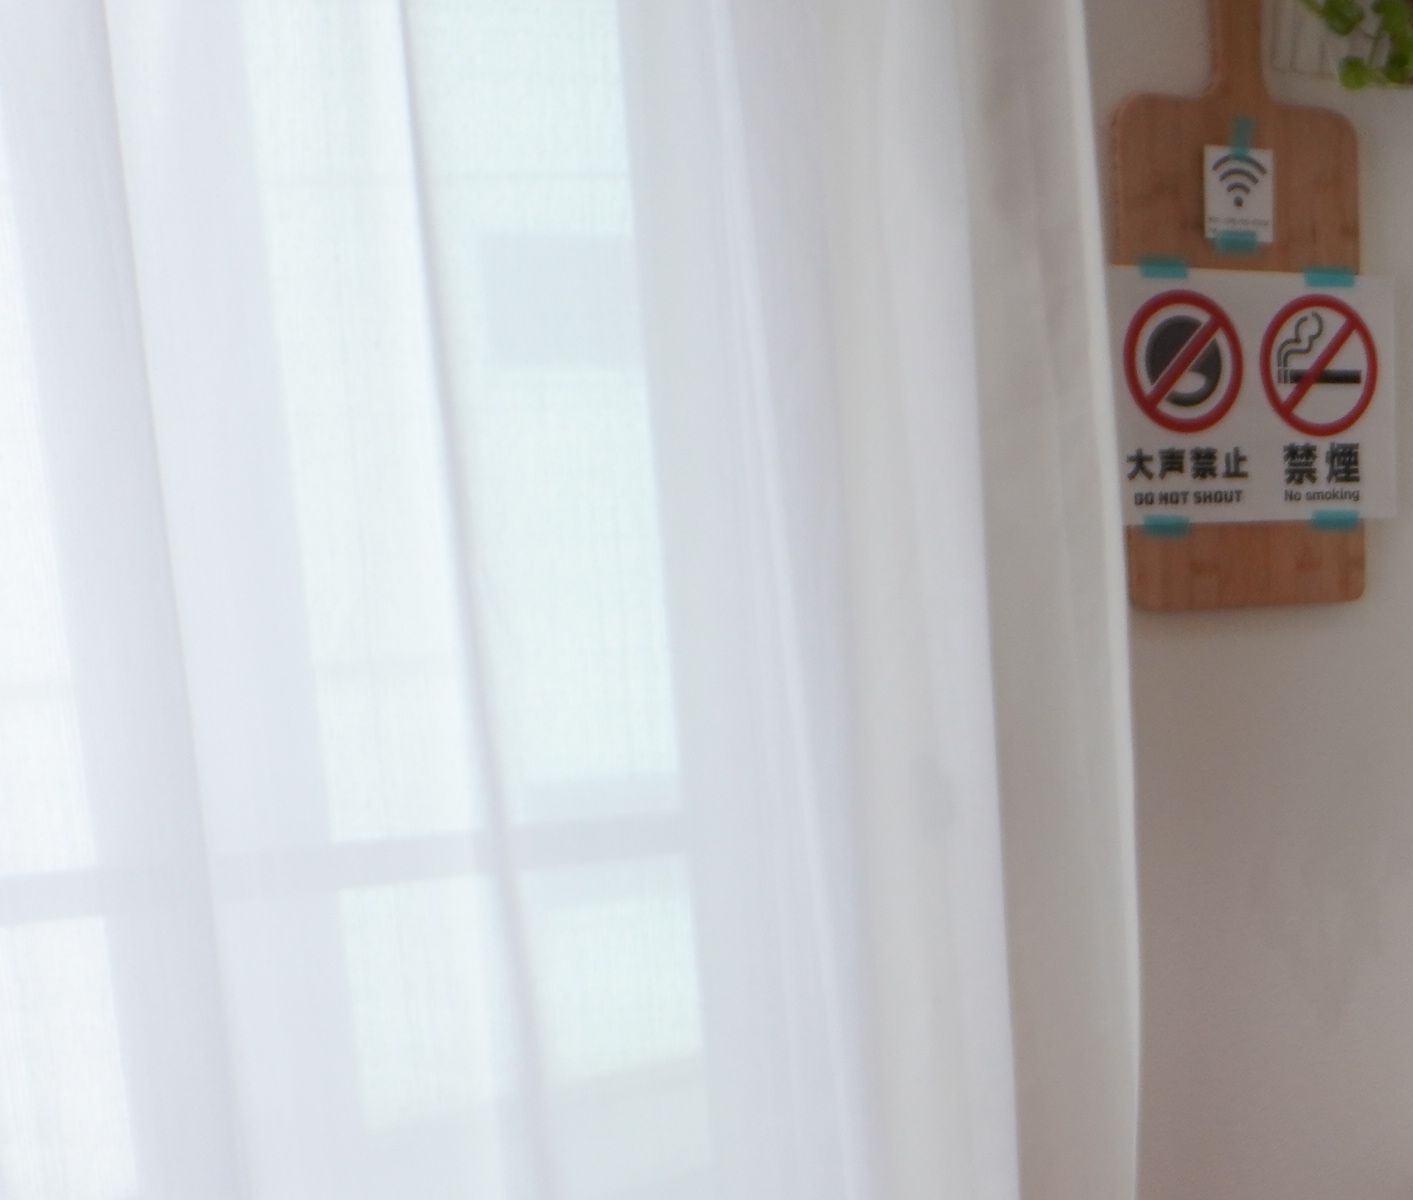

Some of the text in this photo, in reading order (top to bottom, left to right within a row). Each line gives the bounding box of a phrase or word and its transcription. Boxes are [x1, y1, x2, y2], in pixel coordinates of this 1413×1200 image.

[1127, 448, 1249, 481] 大声禁止
[1283, 443, 1360, 484] 禁煙
[1158, 490, 1188, 505] NOT
[1194, 489, 1243, 504] SHOUT
[1284, 488, 1360, 502] No smoking
